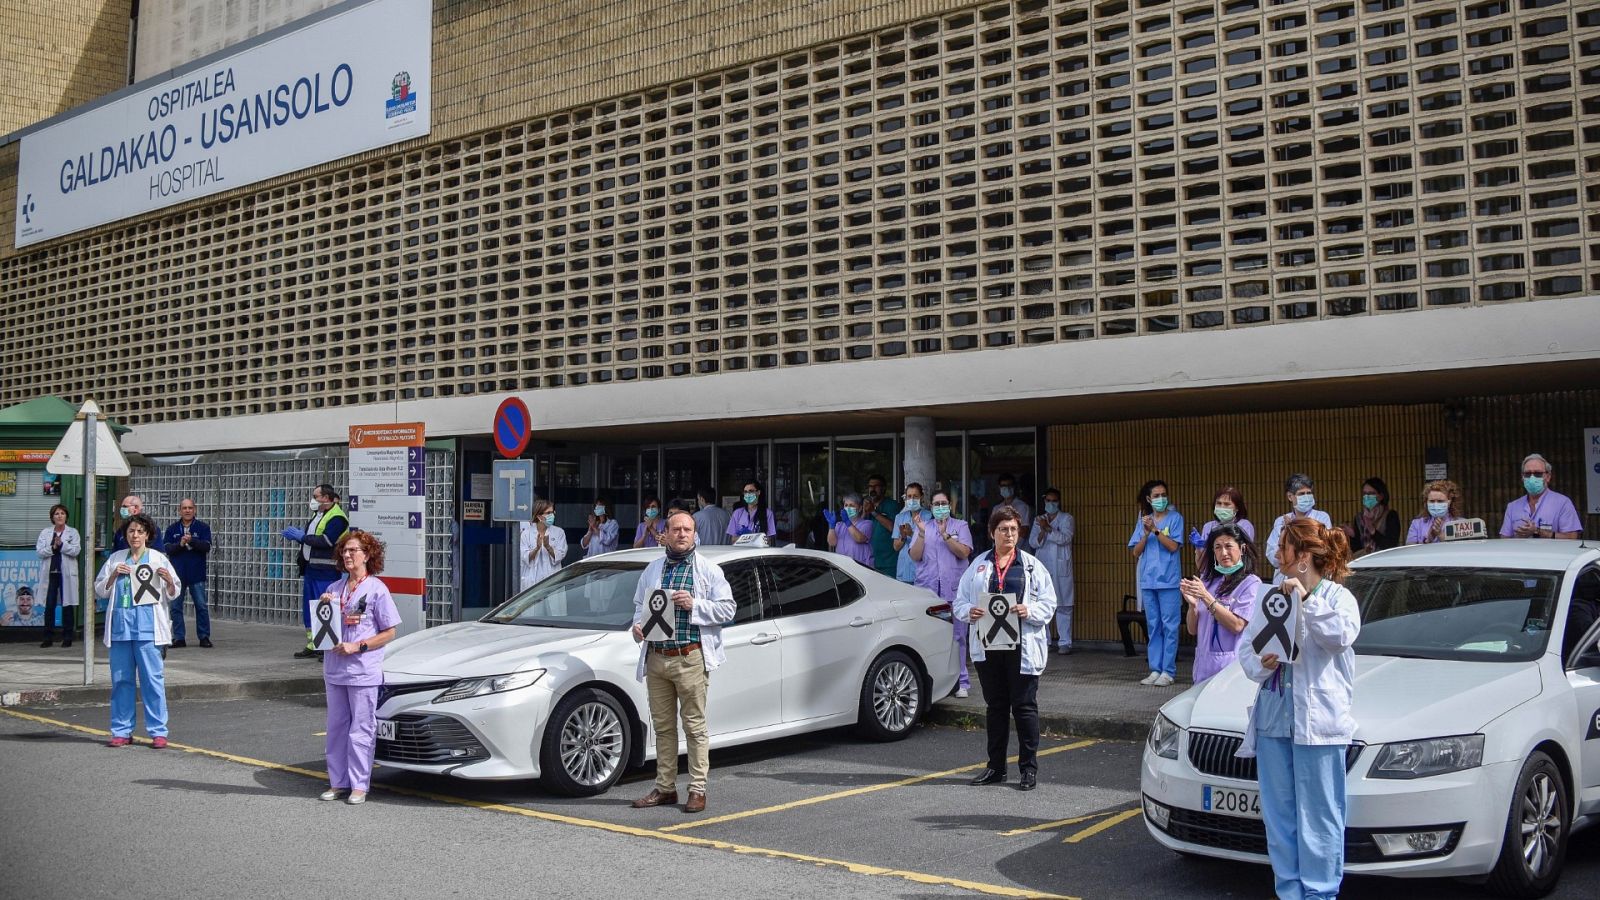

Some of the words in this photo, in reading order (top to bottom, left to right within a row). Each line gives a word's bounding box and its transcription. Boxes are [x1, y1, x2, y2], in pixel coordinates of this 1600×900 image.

[148, 67, 235, 121] OSPITALEA
[60, 124, 176, 194] GALDAKAO
[184, 136, 192, 145] -
[201, 63, 353, 149] USANSOLO
[149, 156, 224, 200] HOSPITAL
[1454, 521, 1473, 531] TAXI
[1, 568, 40, 582] UGAM
[1215, 790, 1261, 814] 2084
